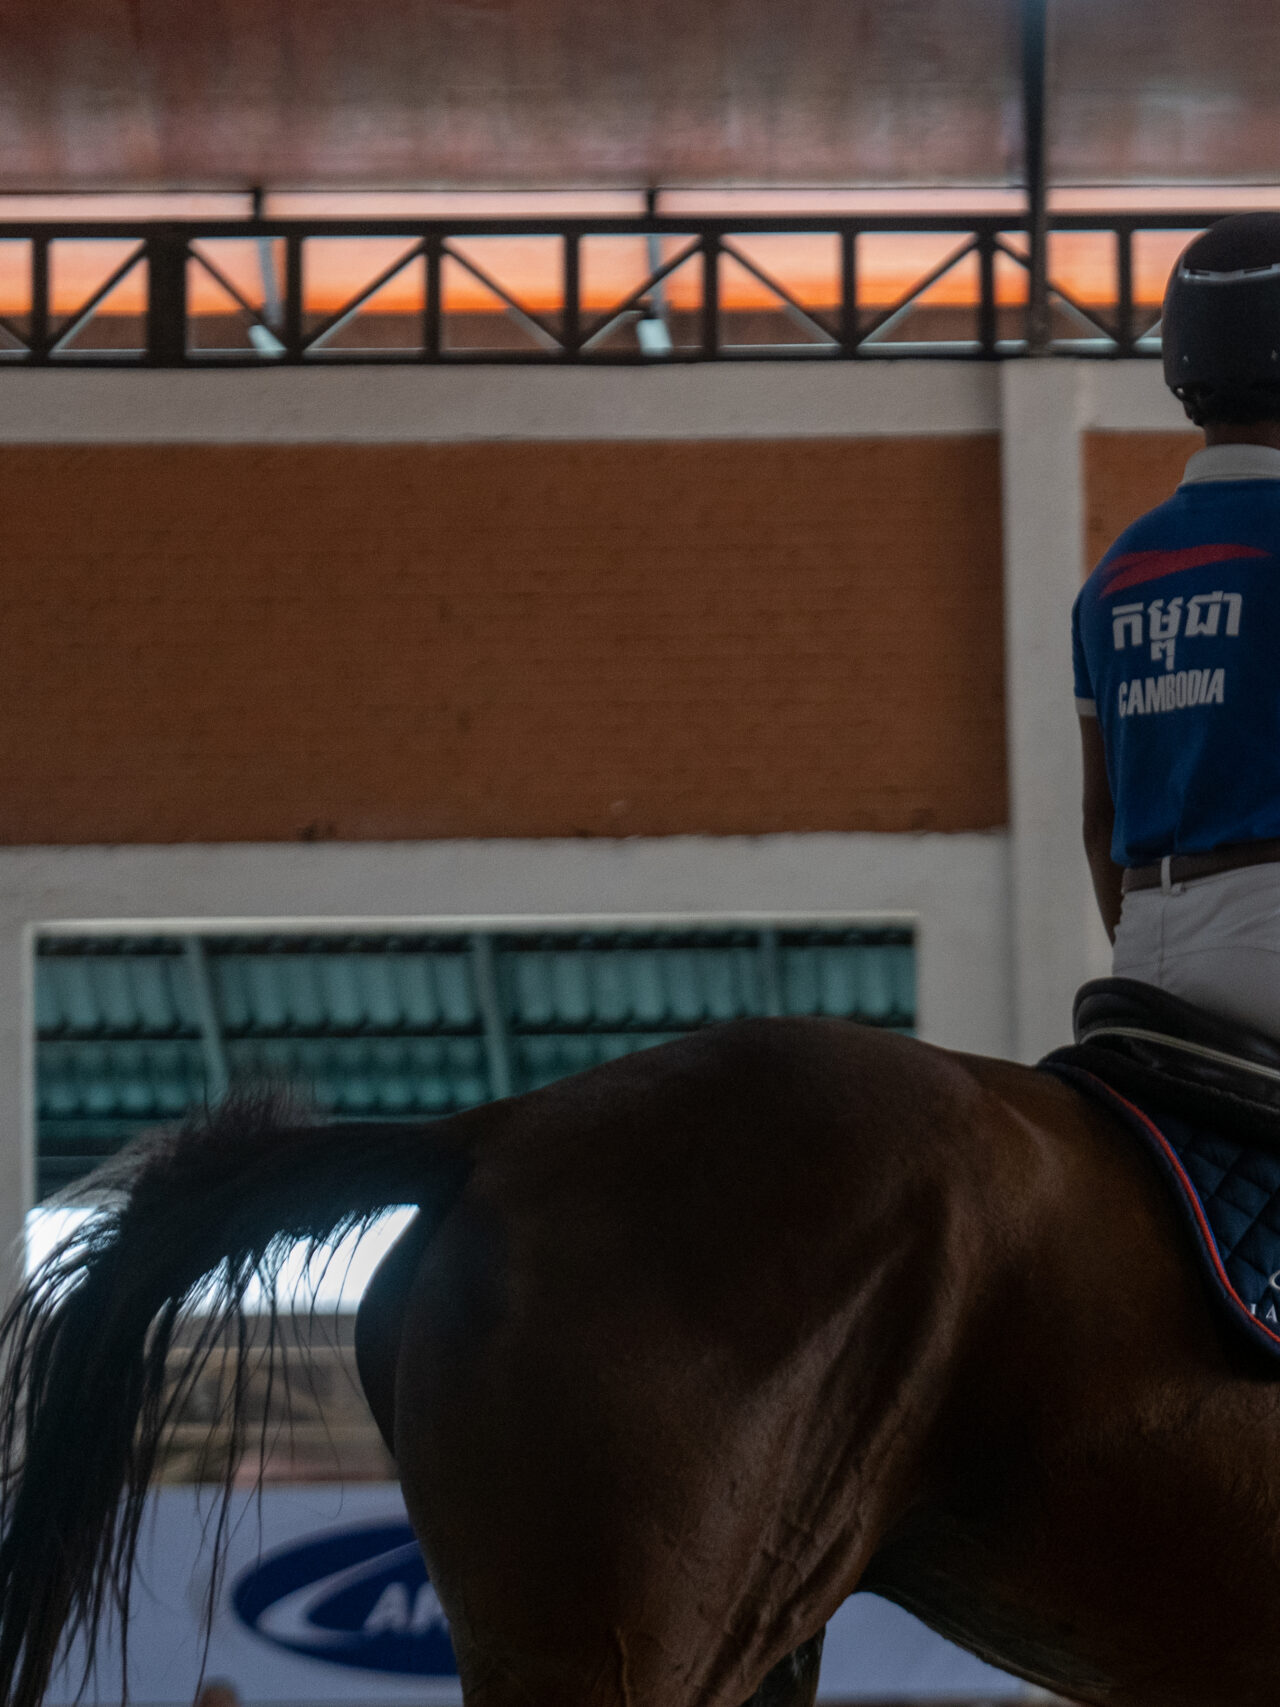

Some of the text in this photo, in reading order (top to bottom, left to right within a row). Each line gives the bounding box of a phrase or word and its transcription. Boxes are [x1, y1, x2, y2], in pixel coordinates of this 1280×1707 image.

[1111, 590, 1243, 671] កម្ពុជា
[1118, 668, 1225, 718] CAMBODIA
